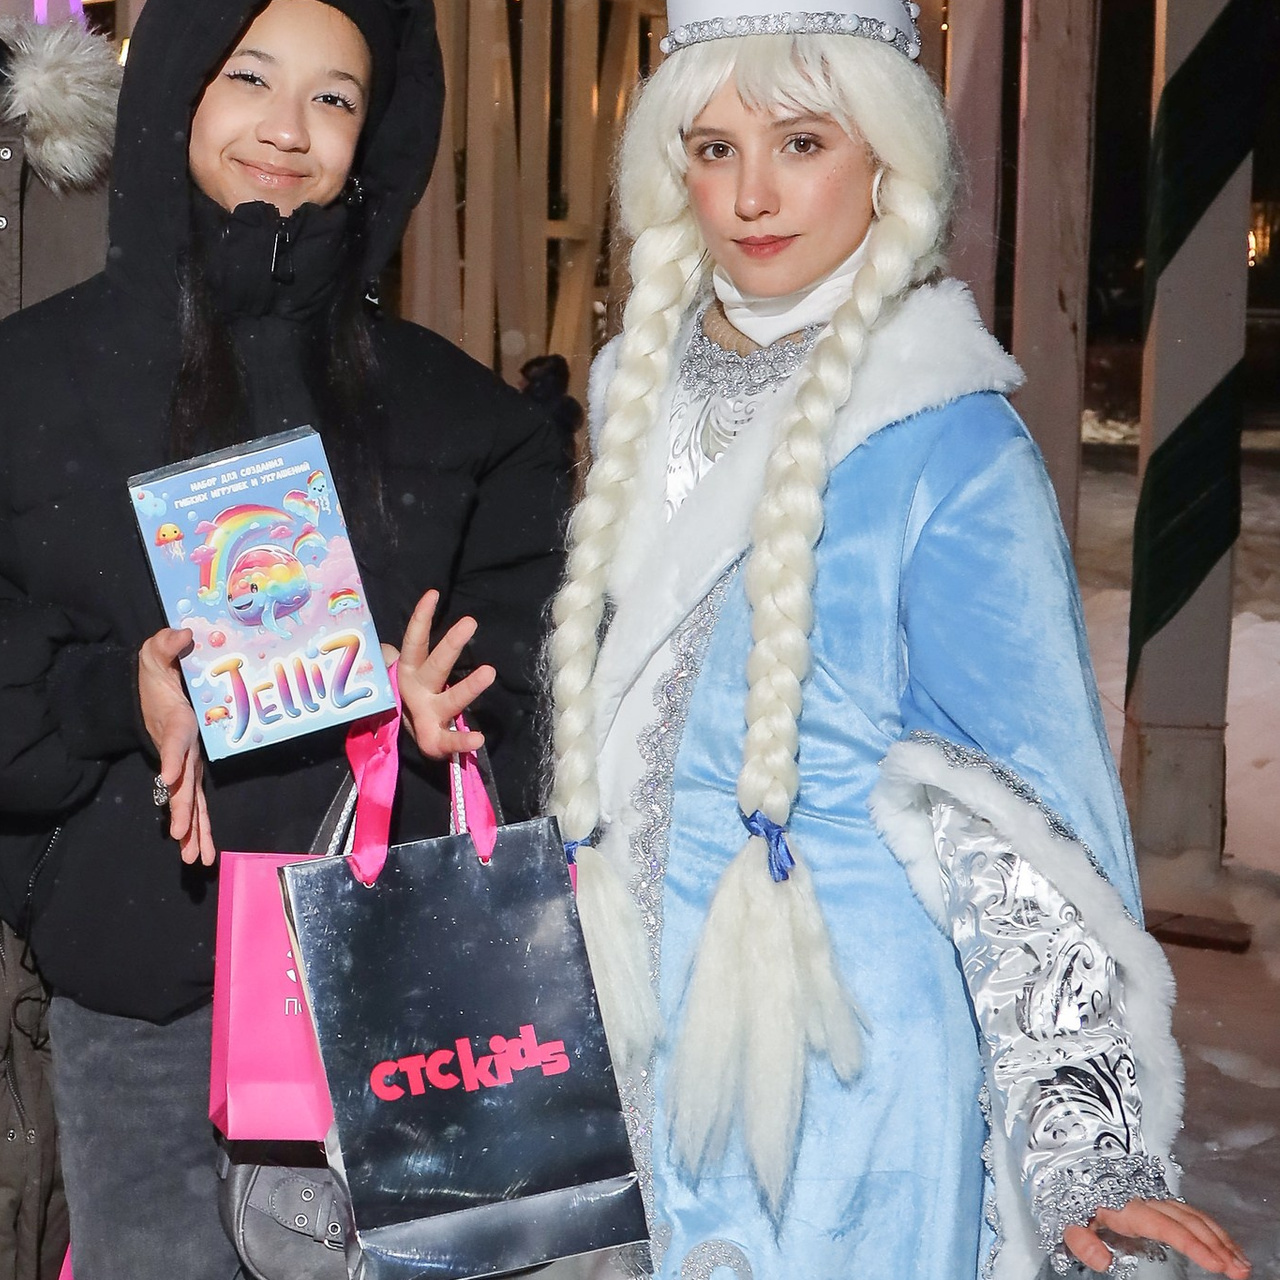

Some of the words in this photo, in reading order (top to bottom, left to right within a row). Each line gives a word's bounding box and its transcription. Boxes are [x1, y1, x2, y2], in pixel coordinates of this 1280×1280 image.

[174, 492, 209, 509] ГИБКИХ
[210, 480, 249, 499] ИГРУШЕК
[251, 478, 258, 487] И
[261, 461, 311, 484] УКРАШЕНИЙ
[190, 477, 217, 492] НАБОР
[221, 471, 238, 484] ДЛЯ
[240, 458, 284, 477] СОЗДАНИЯ
